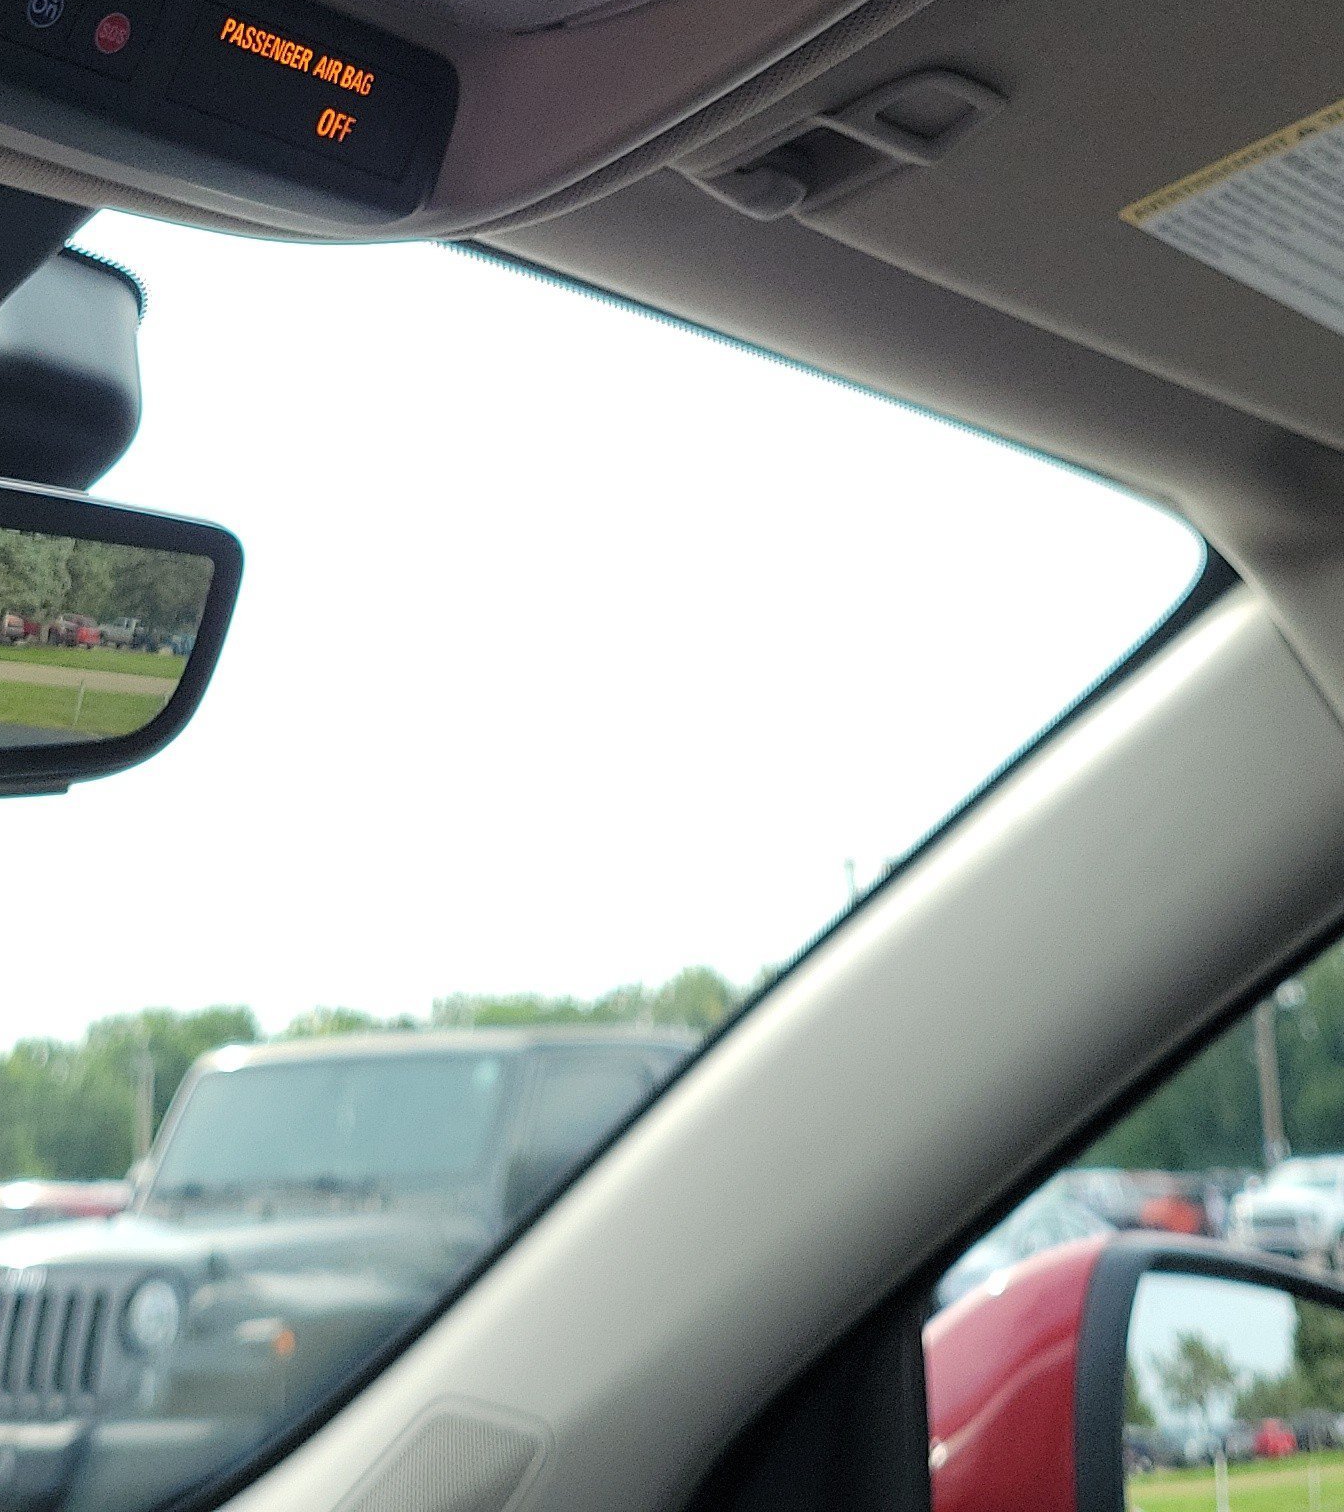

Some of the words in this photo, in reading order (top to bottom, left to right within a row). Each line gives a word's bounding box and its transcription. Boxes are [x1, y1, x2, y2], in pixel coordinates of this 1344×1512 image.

[98, 23, 127, 44] SOS
[220, 17, 313, 73] PASSENGER
[312, 55, 343, 84] AIR
[339, 65, 375, 96] BAG
[316, 107, 357, 143] OFF
